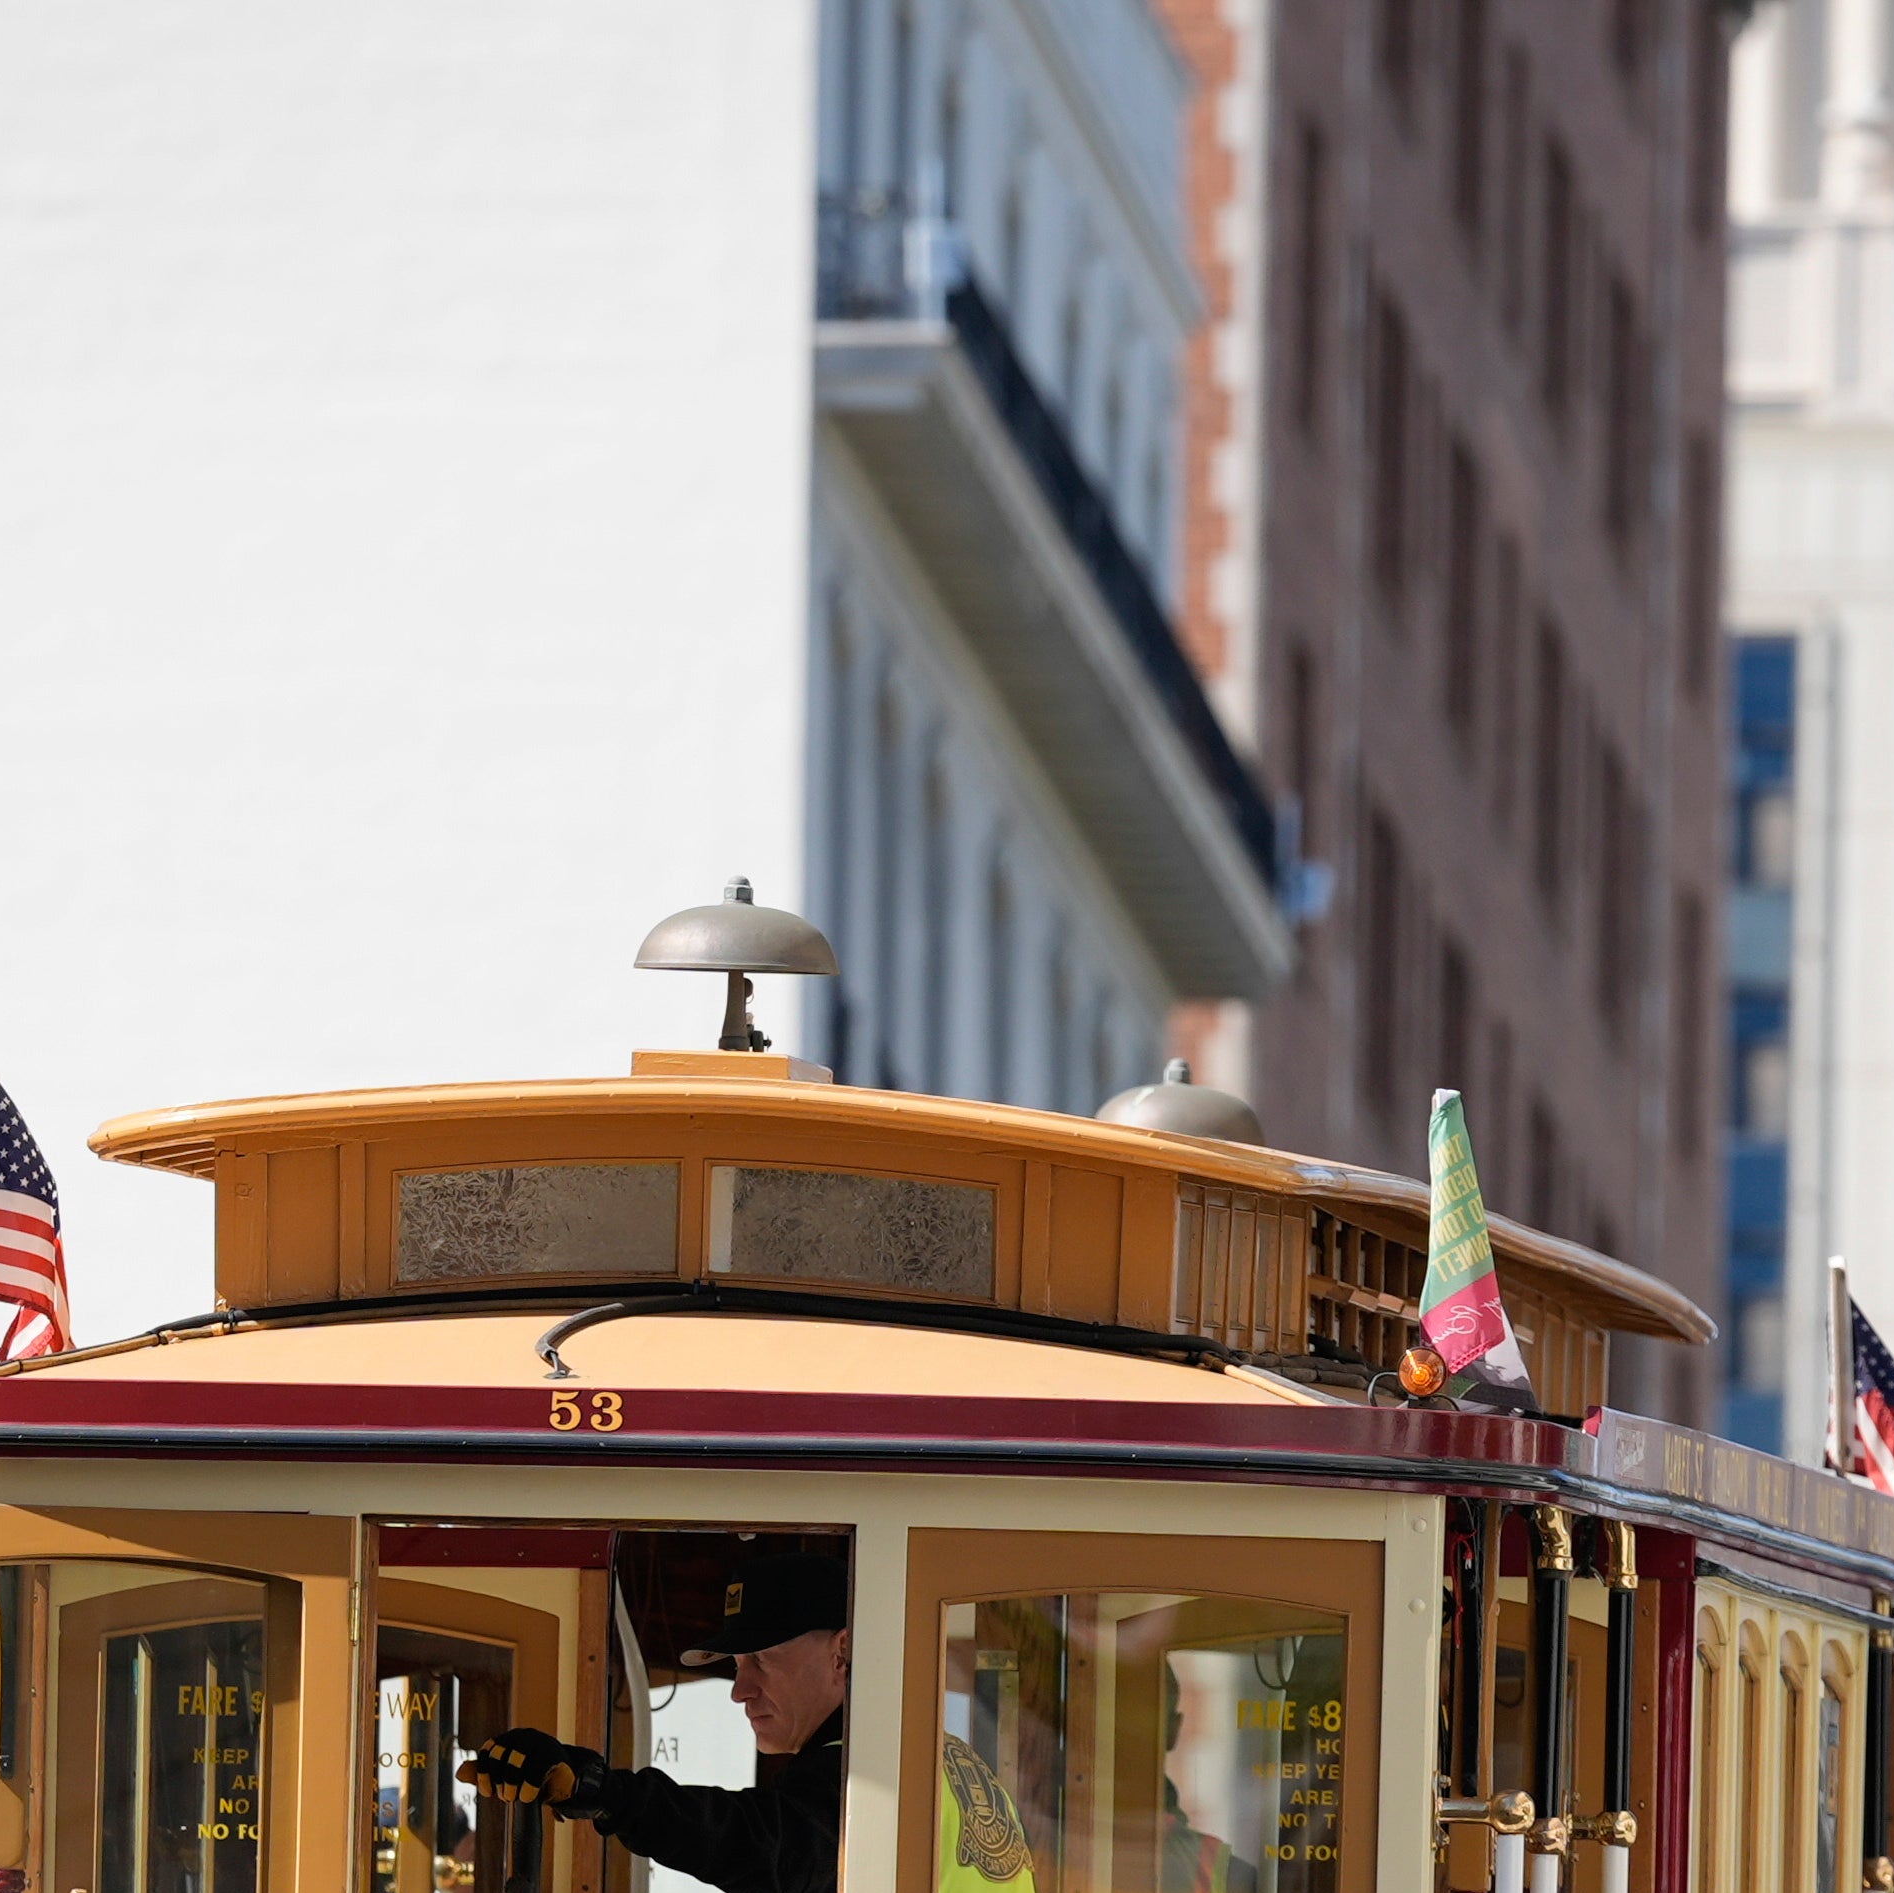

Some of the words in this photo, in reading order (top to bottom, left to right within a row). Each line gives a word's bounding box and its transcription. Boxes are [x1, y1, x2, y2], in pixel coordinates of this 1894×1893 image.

[548, 1389, 625, 1433] 53
[178, 1685, 238, 1716] FARE
[387, 1693, 438, 1721] WAY
[1237, 1700, 1297, 1731] FARE
[193, 1747, 249, 1765] KEEP
[372, 1752, 427, 1769] OOR
[1316, 1763, 1340, 1780] YE
[219, 1797, 249, 1815] NO
[1291, 1790, 1339, 1806] ARE
[198, 1823, 229, 1841] NO
[1264, 1844, 1296, 1861] NO
